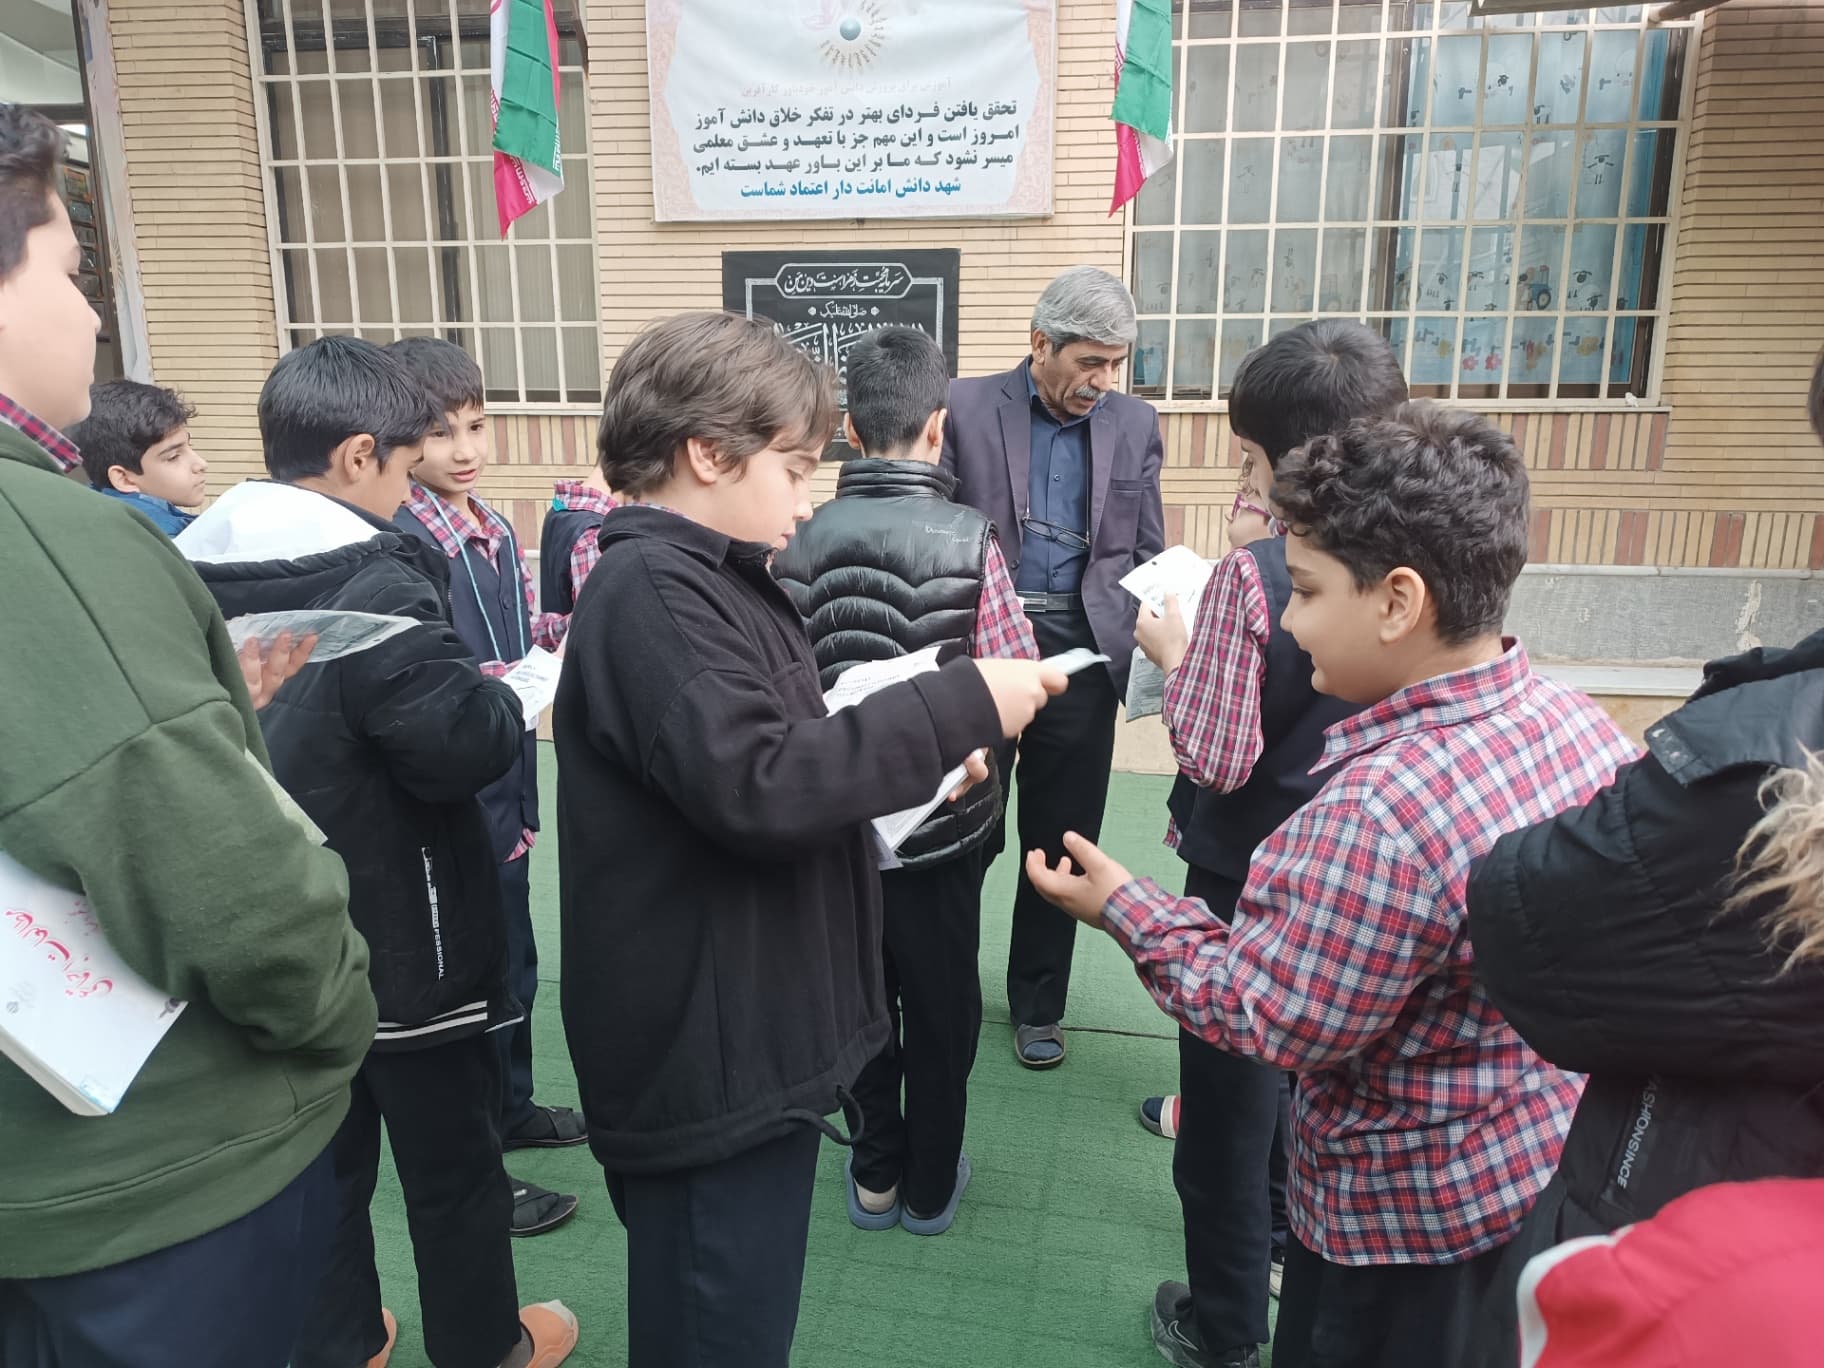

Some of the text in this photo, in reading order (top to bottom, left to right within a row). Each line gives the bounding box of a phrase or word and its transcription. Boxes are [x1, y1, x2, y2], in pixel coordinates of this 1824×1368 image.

[696, 108, 726, 129] آموز
[731, 108, 765, 128] دانش
[770, 107, 801, 127] خلاق
[807, 106, 833, 126] تفکر
[838, 108, 853, 125] در
[858, 107, 882, 124] بهتر
[944, 101, 977, 121] یافتن
[983, 101, 1016, 120] تحقق
[694, 124, 1019, 153] امروز است و این مهم جز با تعهد و عشق معلمی
[724, 159, 760, 174] بسته
[765, 158, 800, 172] عهد
[805, 155, 840, 174] باور
[845, 154, 866, 172] این
[870, 156, 883, 172] بر
[887, 152, 910, 167] ما
[915, 151, 942, 165] که
[946, 150, 977, 169] نشود
[982, 153, 1013, 169] میسر
[741, 177, 960, 199] شهد دانش امانت دار اعتماد شماست
